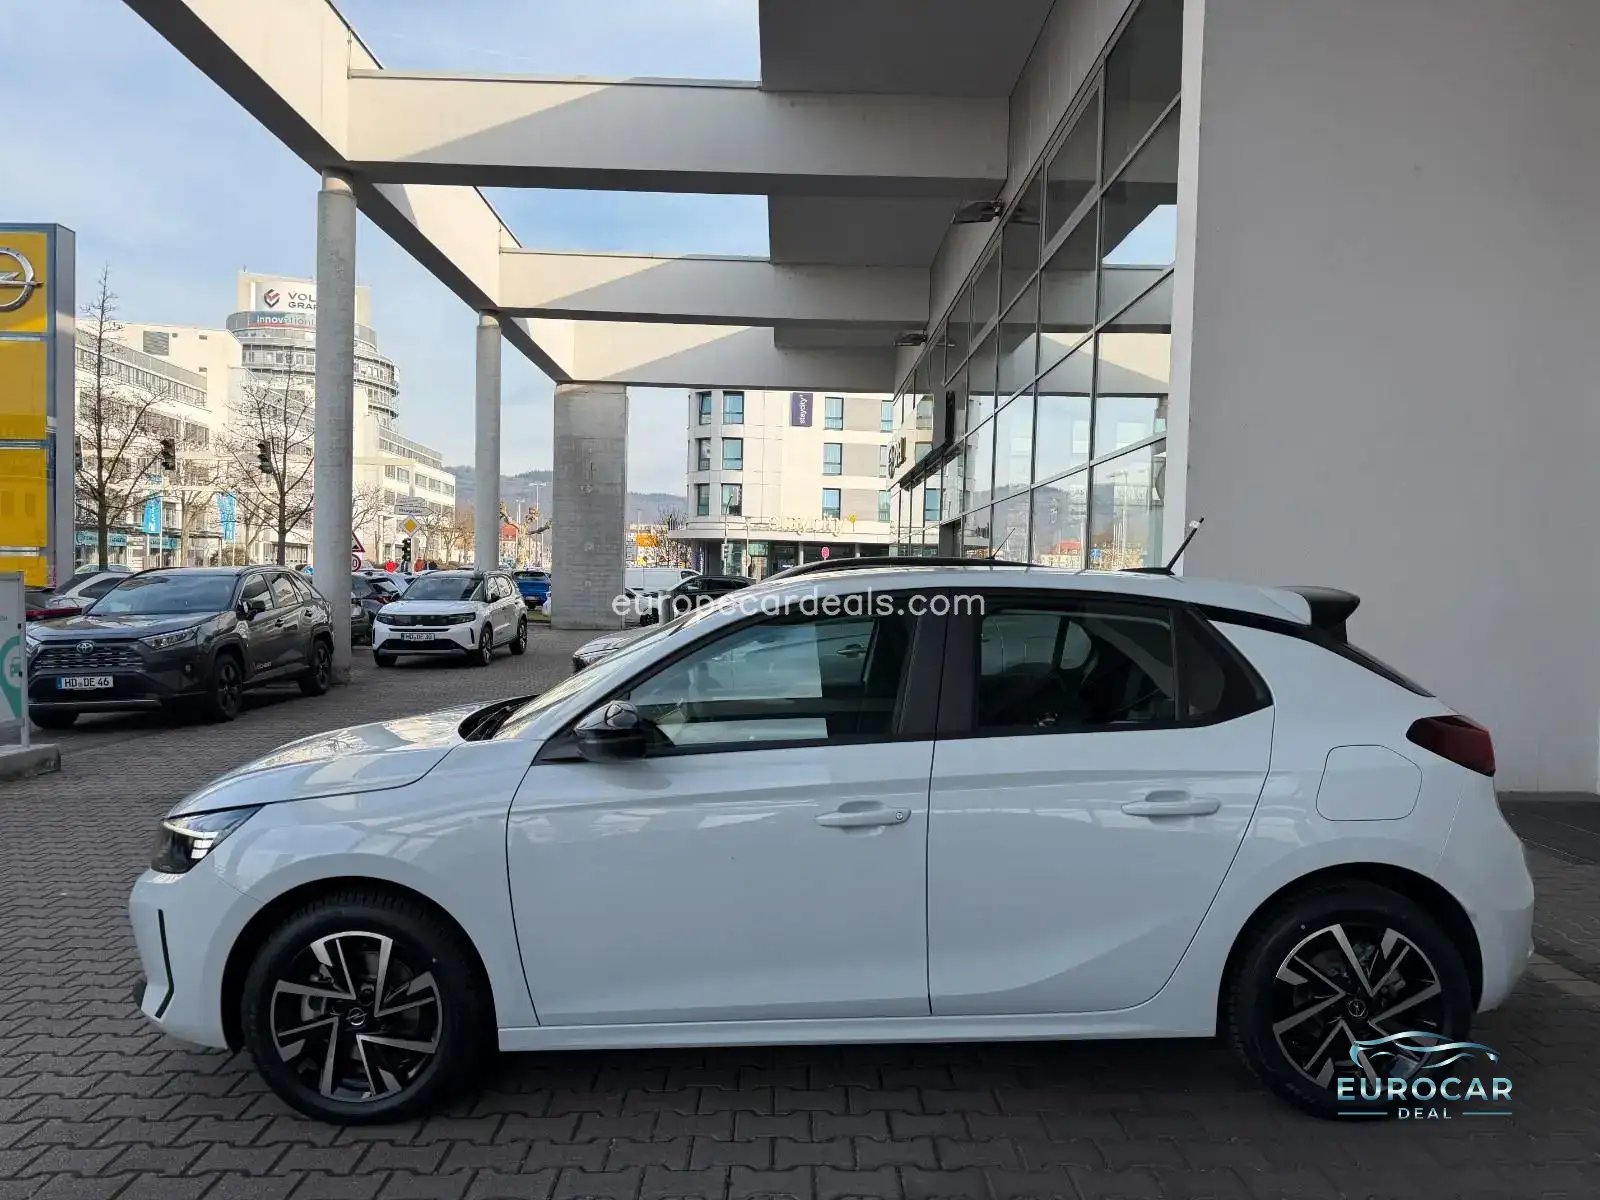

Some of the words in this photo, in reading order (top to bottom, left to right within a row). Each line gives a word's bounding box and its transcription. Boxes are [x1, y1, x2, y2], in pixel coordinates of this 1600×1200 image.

[64, 678, 78, 688] HD
[83, 677, 95, 687] DE
[97, 677, 110, 687] 46
